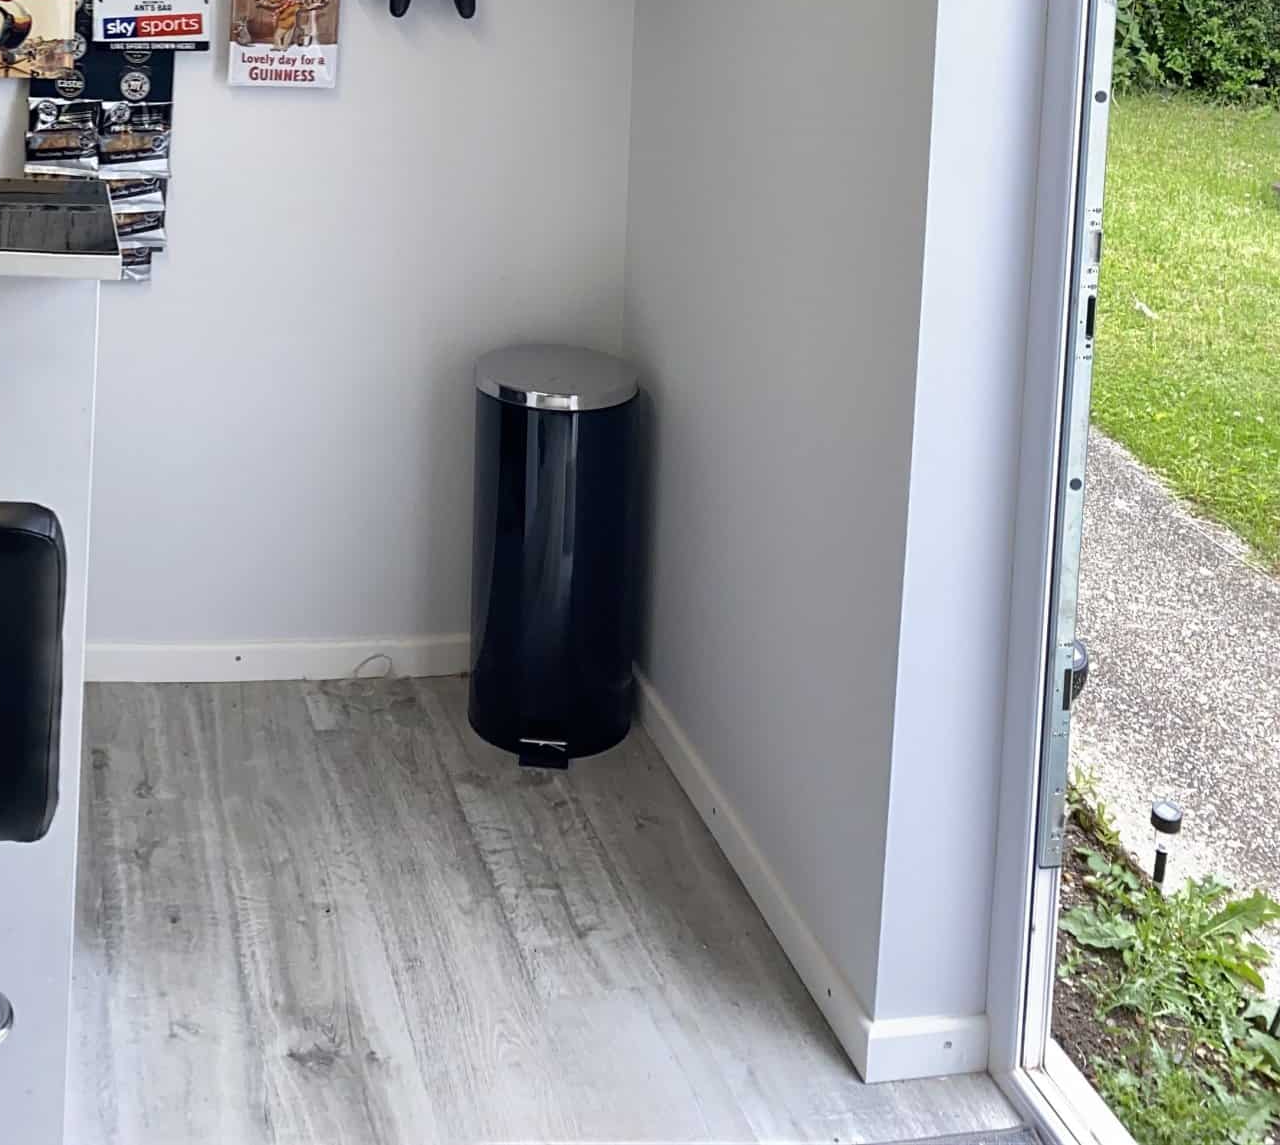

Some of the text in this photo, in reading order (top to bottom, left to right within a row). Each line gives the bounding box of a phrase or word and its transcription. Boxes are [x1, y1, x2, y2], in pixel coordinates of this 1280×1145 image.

[106, 17, 199, 36] sky sports
[241, 52, 325, 66] Lovely day for a
[249, 66, 315, 82] GUINNESS
